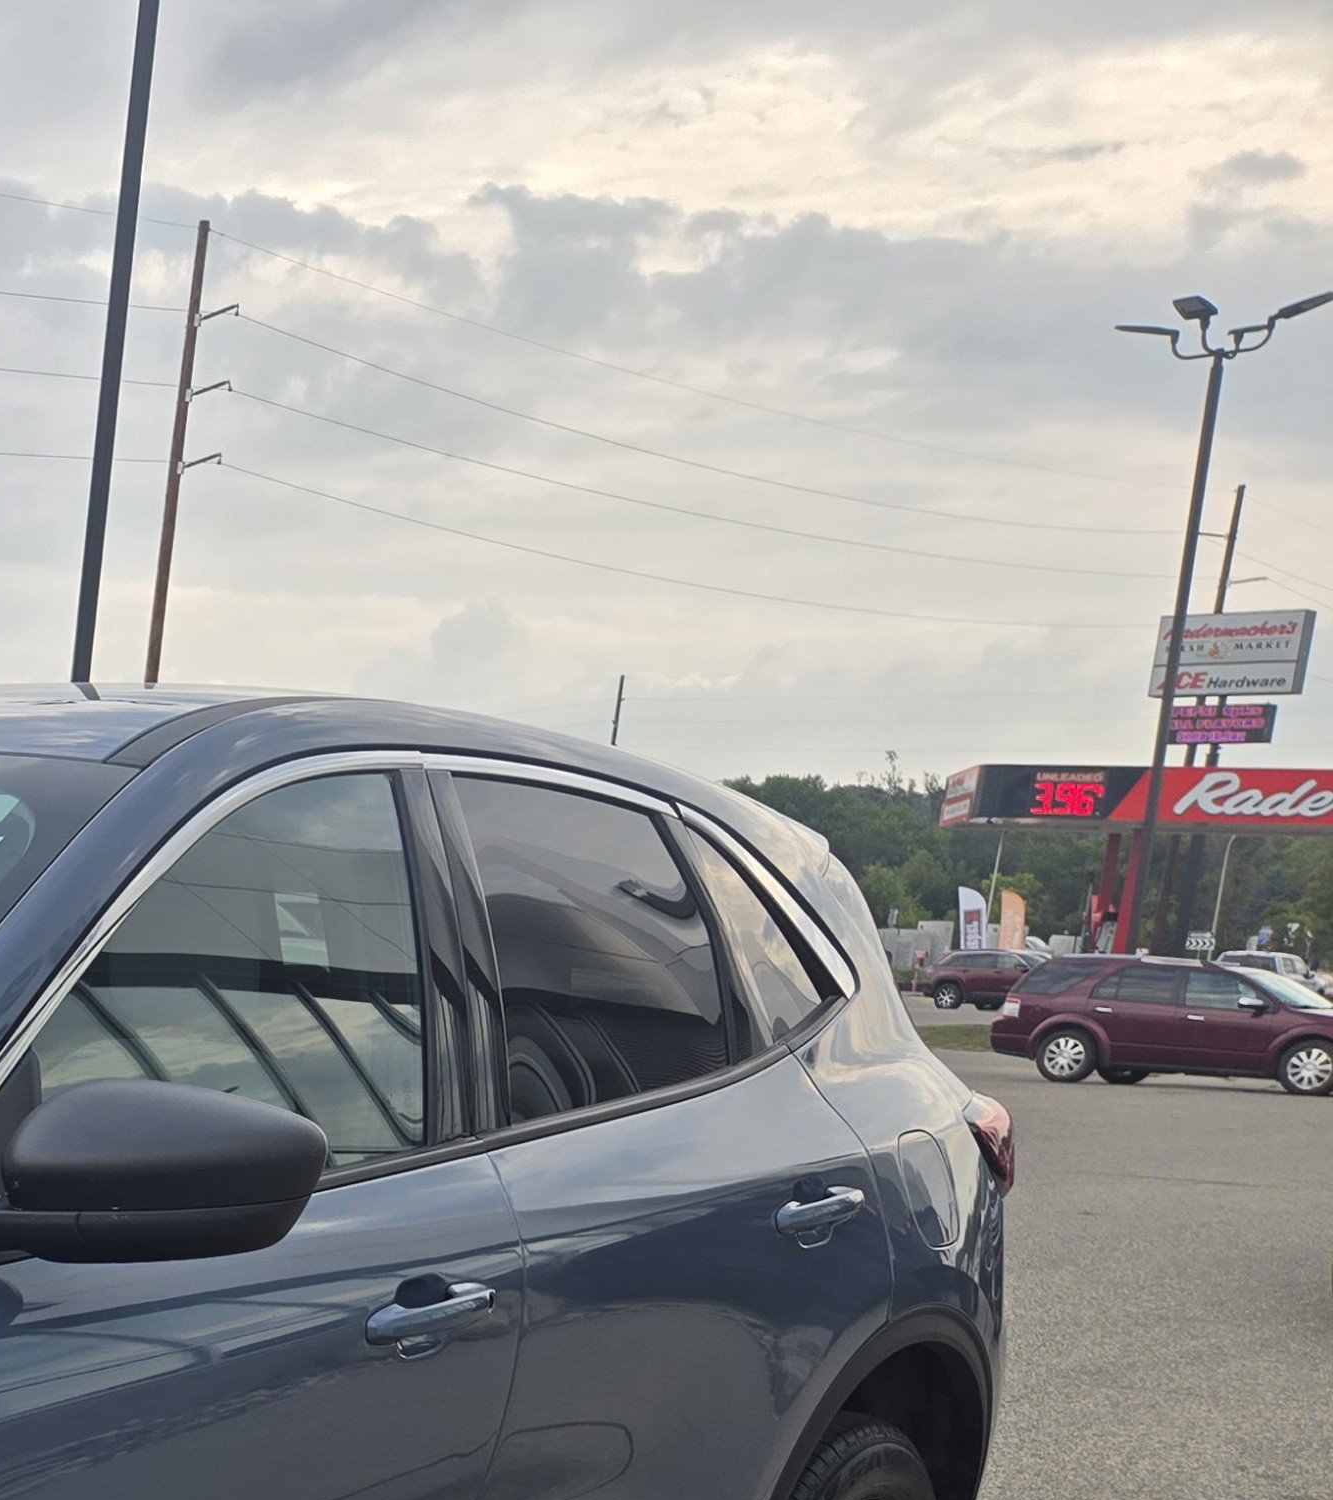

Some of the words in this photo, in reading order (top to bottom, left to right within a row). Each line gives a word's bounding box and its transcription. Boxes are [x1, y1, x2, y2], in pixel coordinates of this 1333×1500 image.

[1233, 640, 1290, 650] MARKET
[1206, 676, 1287, 689] Hardware
[1036, 772, 1103, 782] UNLEADED
